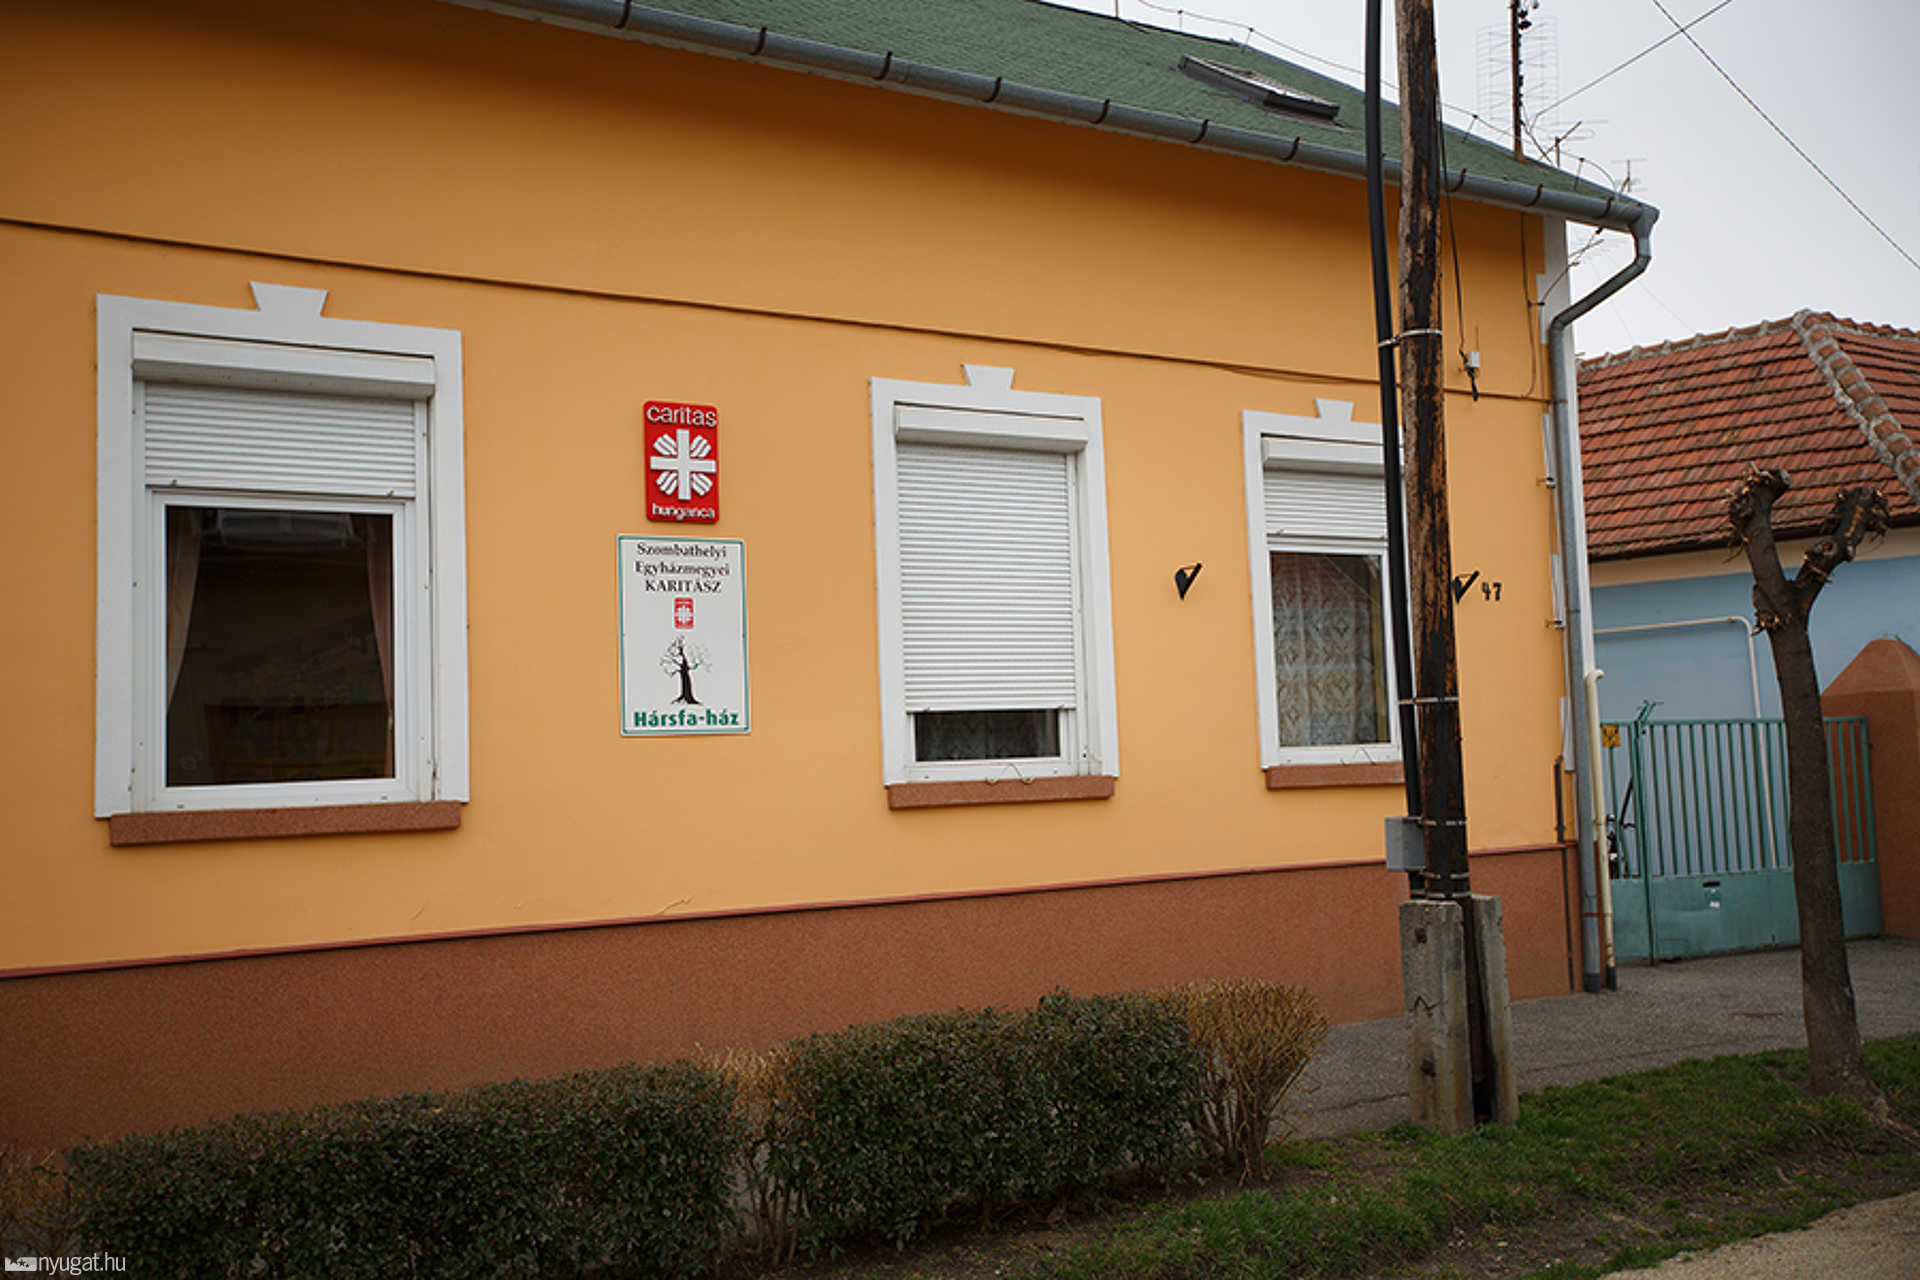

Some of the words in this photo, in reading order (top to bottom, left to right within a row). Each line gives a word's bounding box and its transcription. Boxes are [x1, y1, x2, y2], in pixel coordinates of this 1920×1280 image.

[646, 406, 717, 427] caritas
[636, 543, 727, 561] Szombathelyi
[635, 561, 730, 579] Egyházmegyei
[1482, 582, 1502, 601] 47
[634, 708, 739, 727] Hársfa-ház
